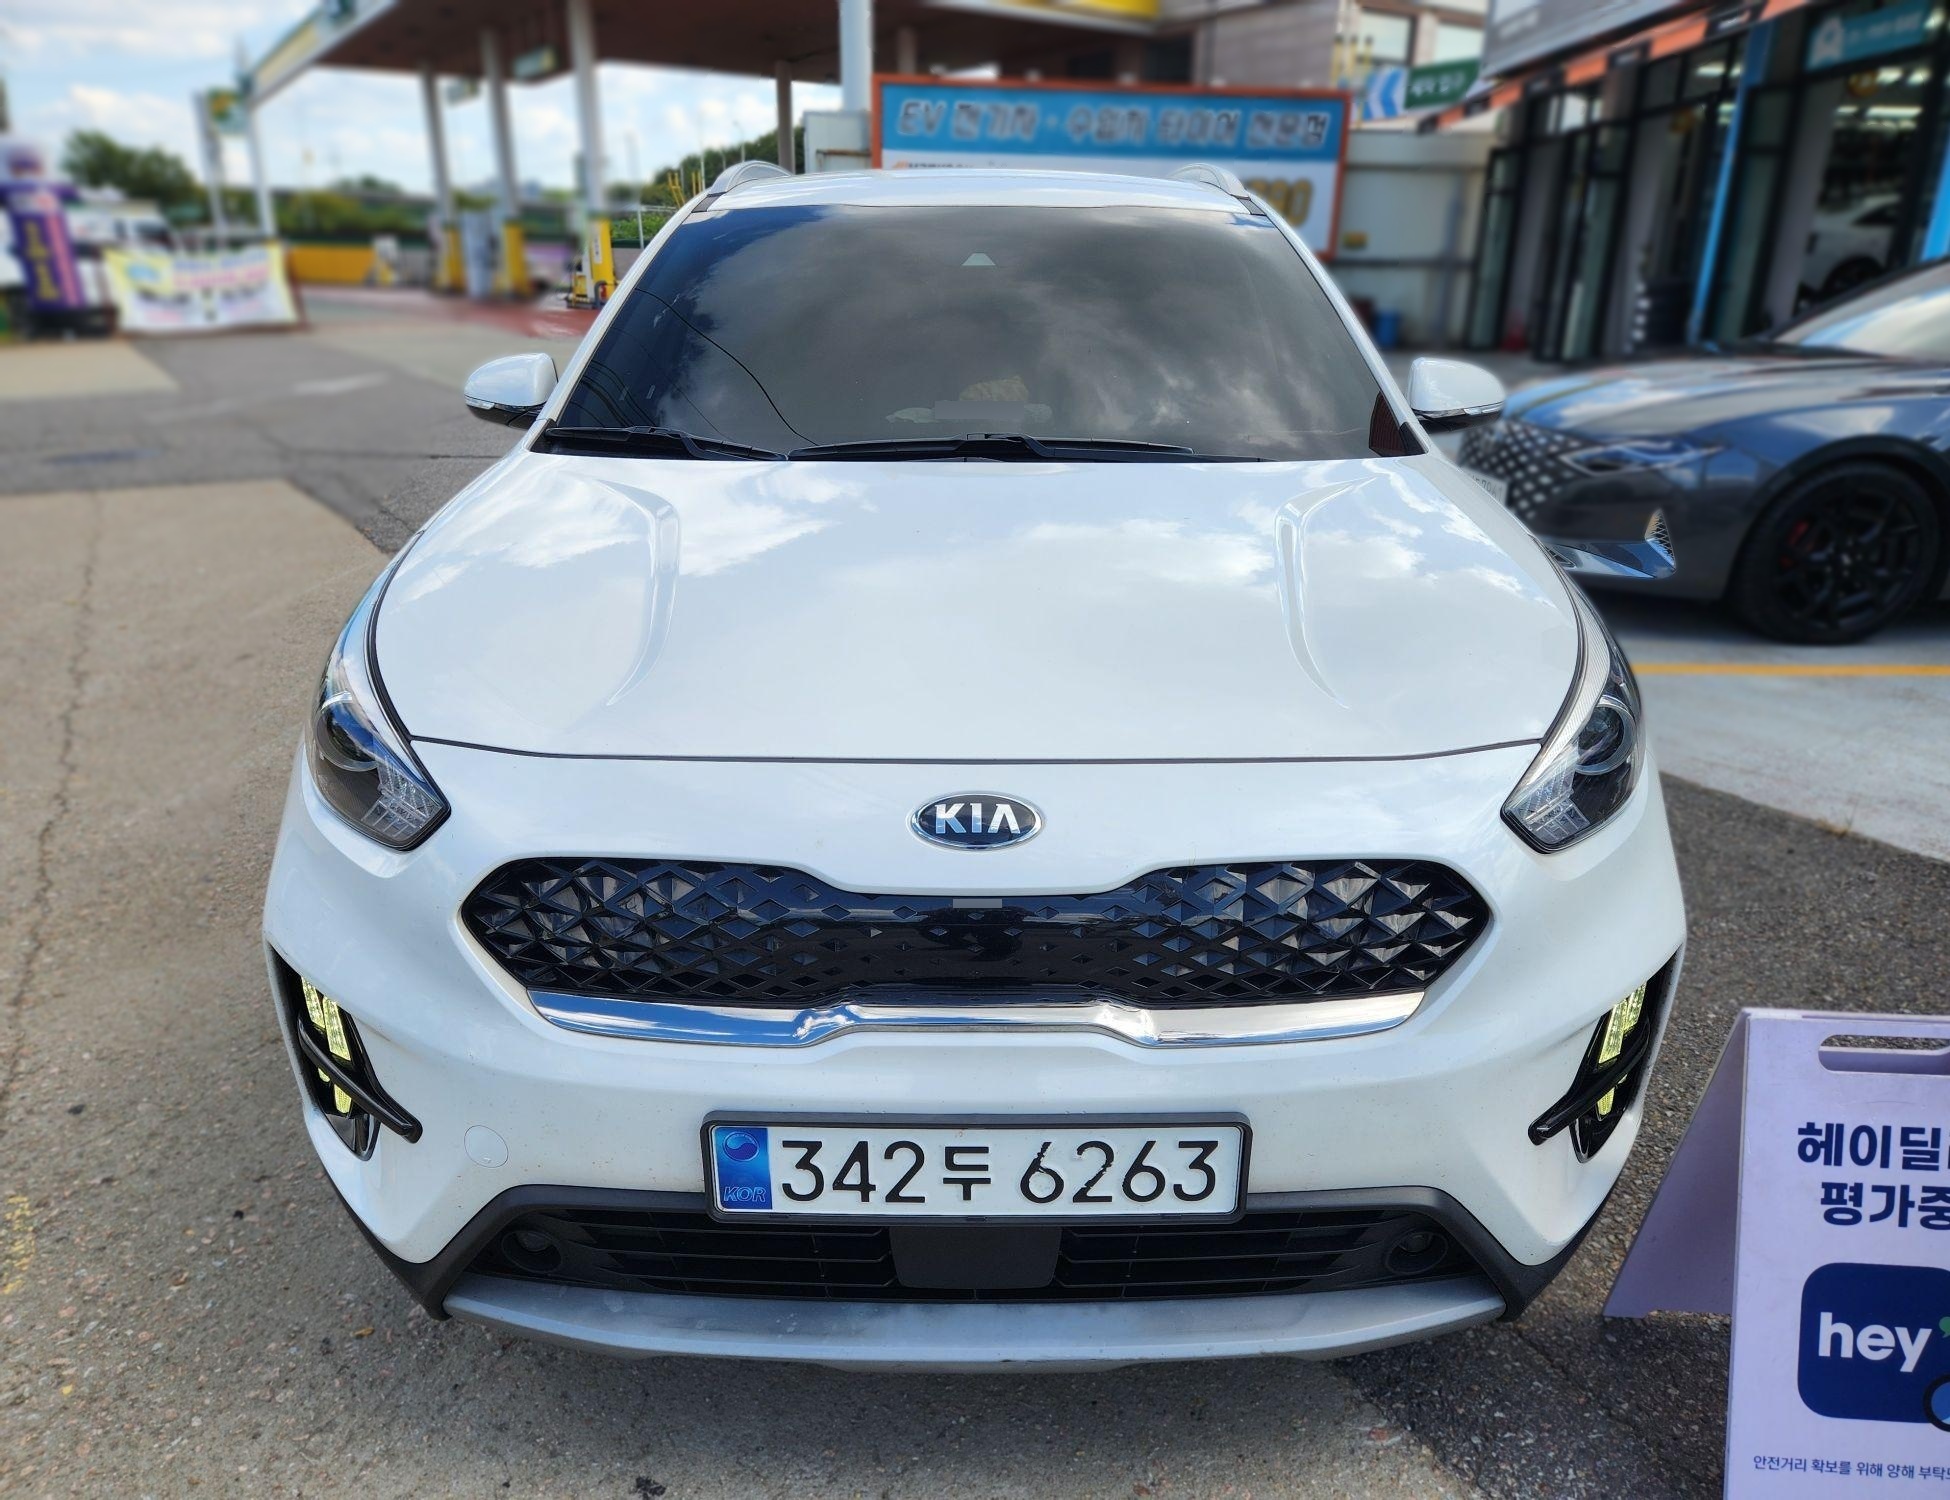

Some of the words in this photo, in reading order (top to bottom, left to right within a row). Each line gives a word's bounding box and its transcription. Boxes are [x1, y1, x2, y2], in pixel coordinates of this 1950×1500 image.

[899, 100, 947, 137] EV
[935, 803, 1021, 834] KIA
[1797, 1121, 1950, 1172] 헤이딜
[781, 1140, 992, 1204] 342두
[1019, 1140, 1220, 1204] 6263
[723, 1186, 767, 1203] KOR
[1820, 1181, 1950, 1231] 평가중
[1818, 1311, 1933, 1373] hey
[1753, 1455, 1807, 1472] 안전거리
[1811, 1458, 1851, 1476] 확보를
[1856, 1461, 1883, 1477] 위해
[1887, 1463, 1915, 1479] 양해
